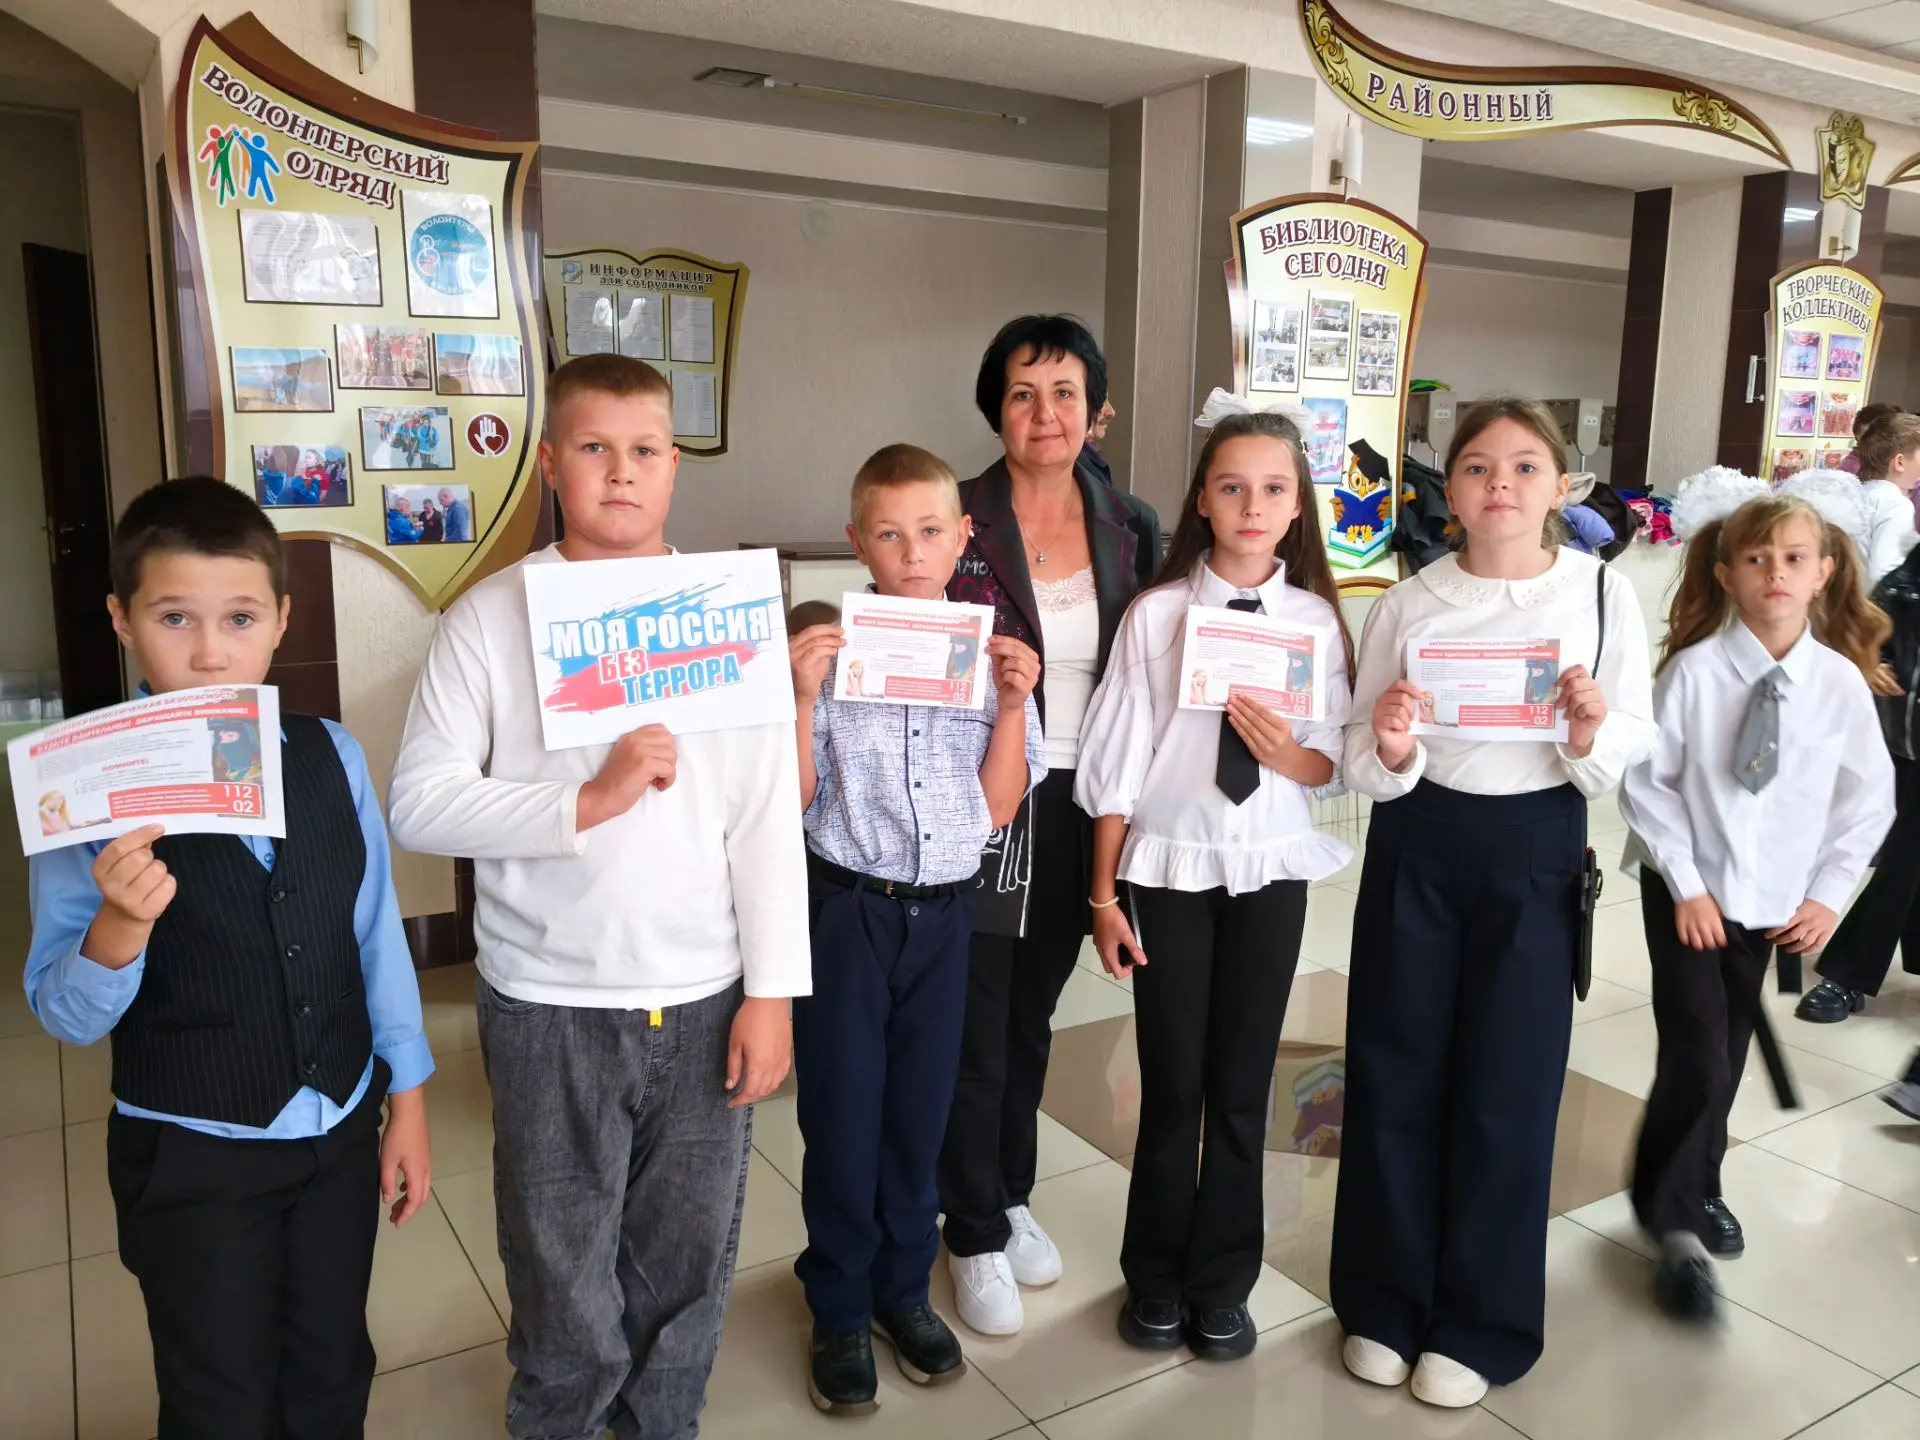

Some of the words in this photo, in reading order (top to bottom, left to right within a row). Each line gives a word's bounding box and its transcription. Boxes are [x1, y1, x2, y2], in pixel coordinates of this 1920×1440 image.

[1367, 72, 1553, 121] РАЙОННЫЙ
[202, 64, 448, 182] ВОЛОНТЕРСКИЙ
[287, 151, 393, 208] ОТРЯД
[1260, 218, 1408, 270] БИБЛИОТЕКА
[590, 263, 714, 284] ИНФОРМАЦИЯ
[626, 278, 705, 292] сотрудников
[1285, 252, 1388, 289] СЕГОДНЯ
[1787, 274, 1874, 309] ТВОРЧЕСКИЕ
[1783, 298, 1872, 335] КОЛЛЕКТИВЫ
[550, 618, 627, 660] МОЯ
[637, 605, 771, 649] РОССИЯ
[600, 648, 648, 683] БЕЗ
[622, 654, 743, 707] ТЕРРОРА
[950, 681, 967, 691] 112
[1290, 694, 1306, 704] 112
[1529, 705, 1549, 715] 112
[1534, 716, 1548, 725] 02
[223, 784, 253, 799] 112
[232, 800, 254, 813] 02
